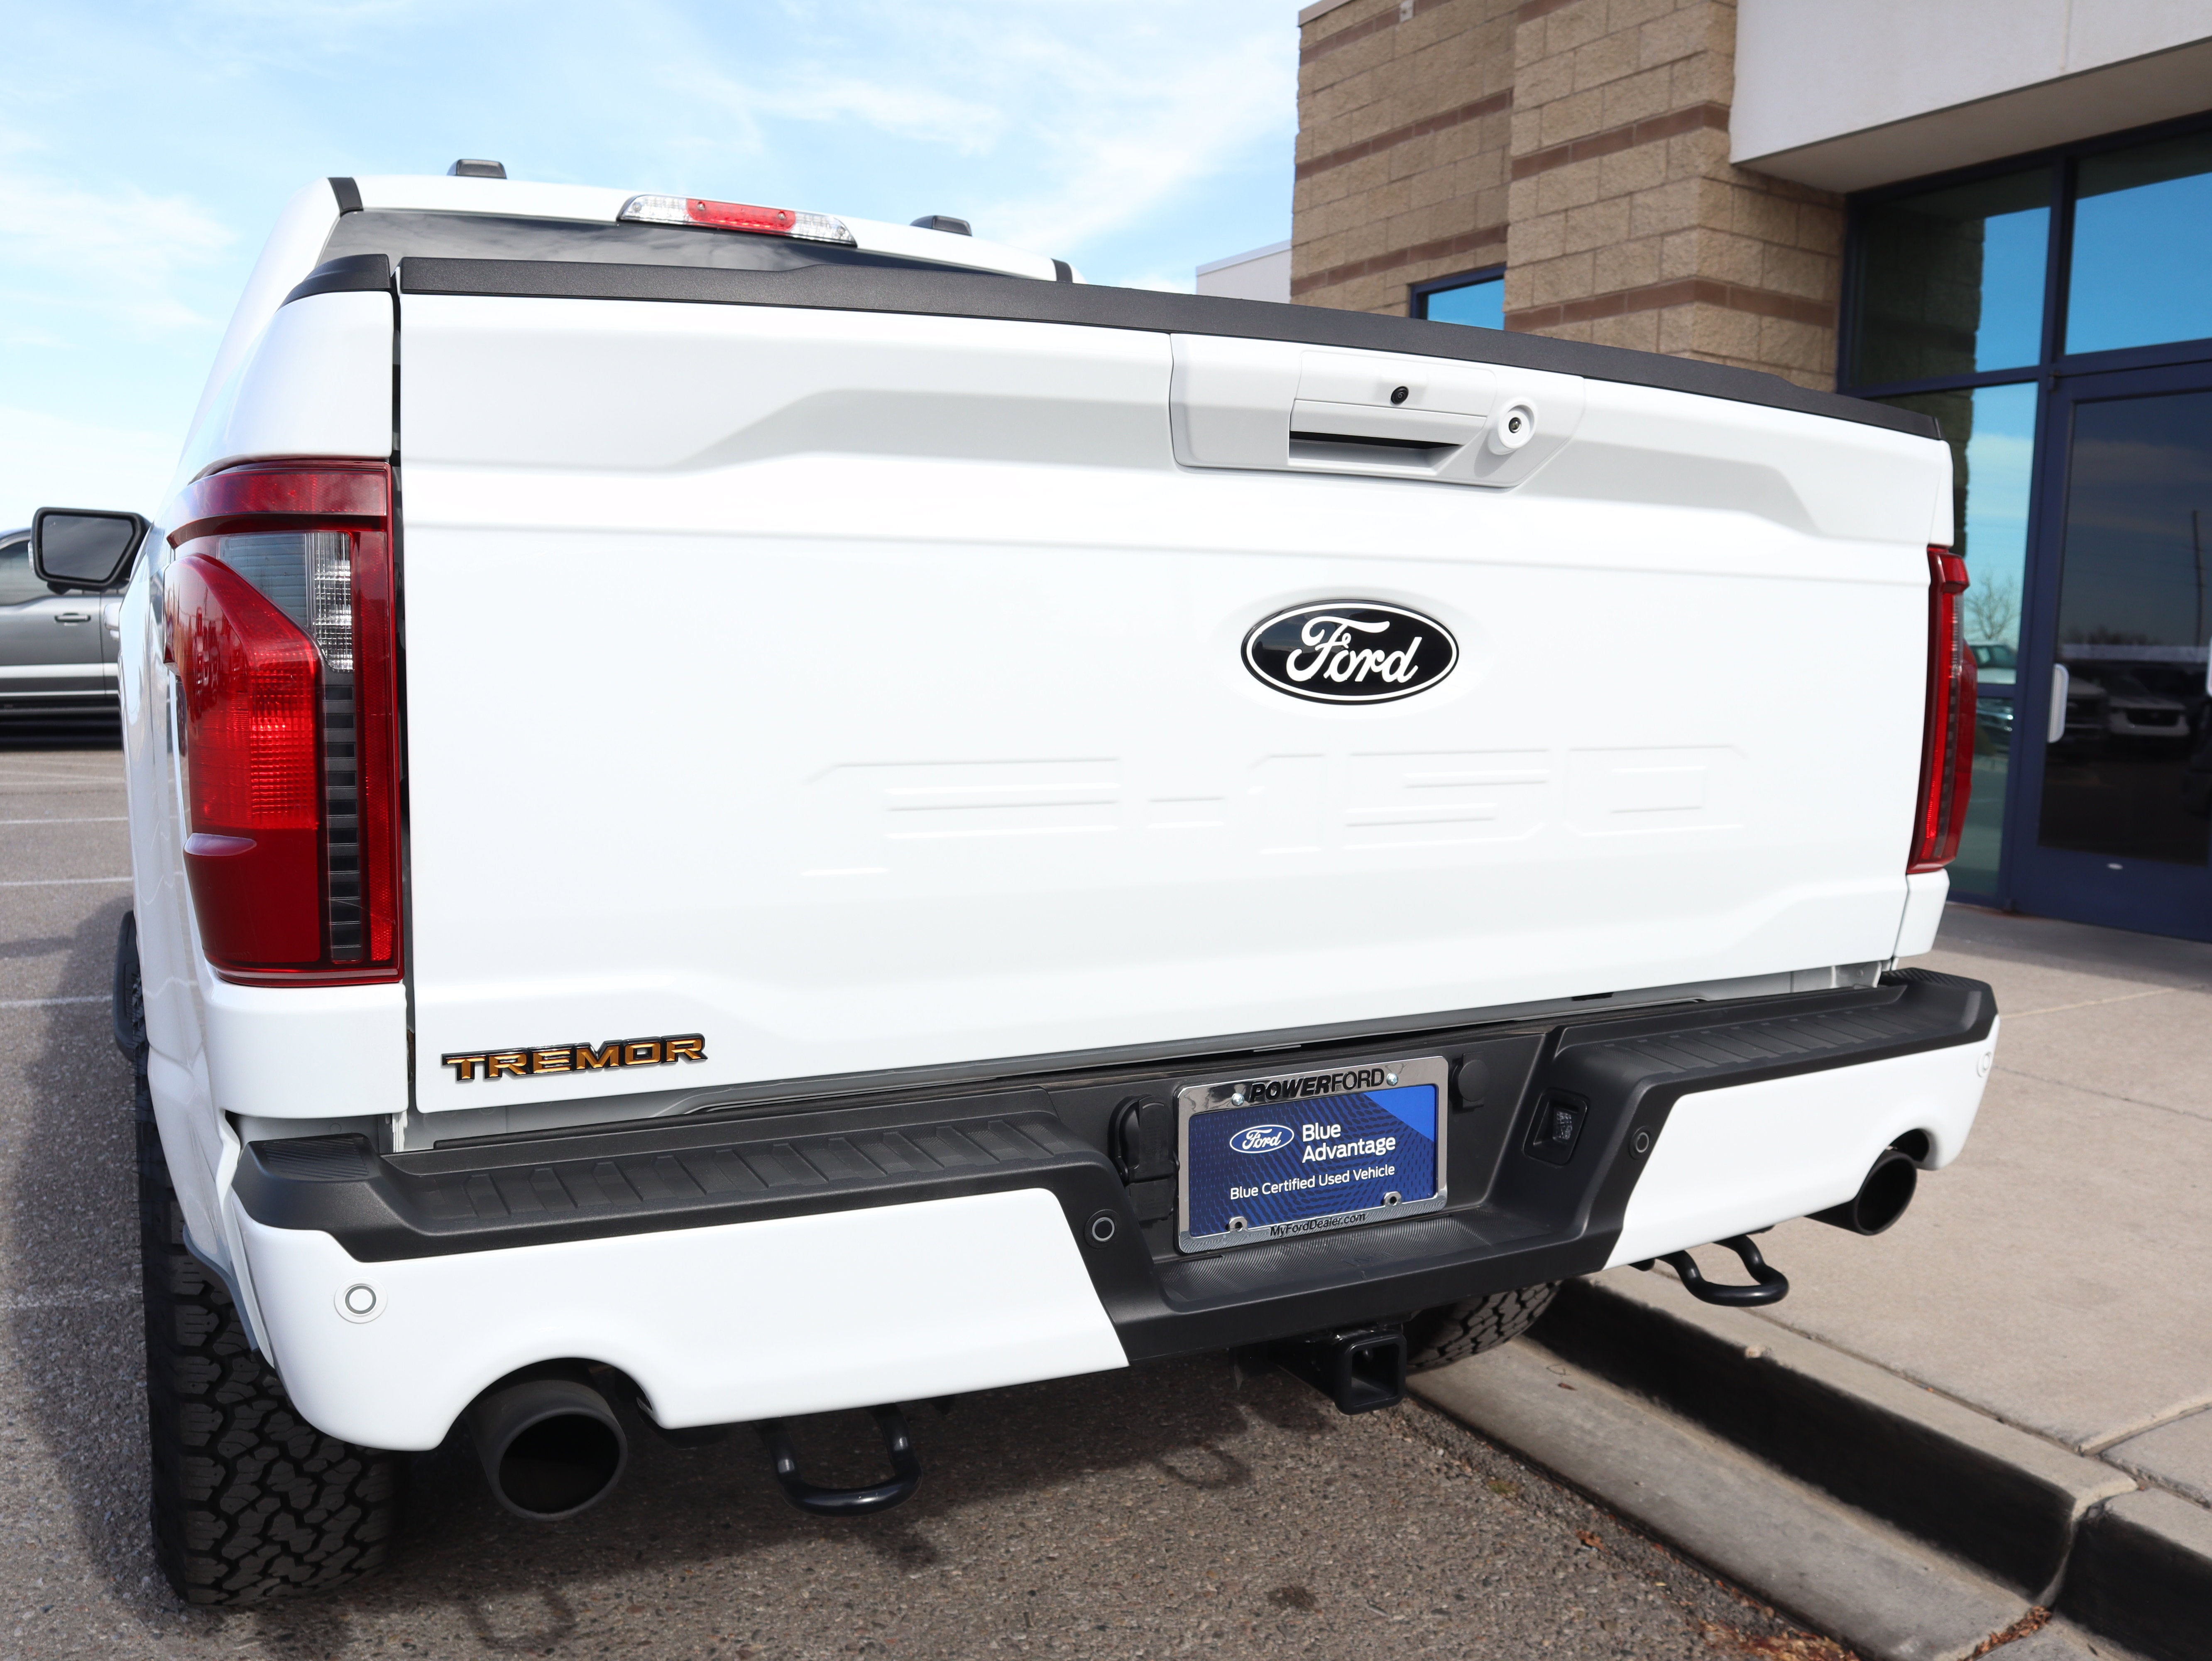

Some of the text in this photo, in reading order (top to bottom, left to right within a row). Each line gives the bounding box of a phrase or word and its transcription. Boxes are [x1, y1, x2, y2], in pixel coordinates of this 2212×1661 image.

[1286, 616, 1422, 683] Ford
[441, 1032, 708, 1081] TREMOR
[1248, 1068, 1385, 1104] POWERFORD
[1242, 1129, 1282, 1150] Ford
[1302, 1122, 1341, 1142] Blue
[1302, 1137, 1396, 1163] Advantage
[1230, 1164, 1395, 1200] Blue Certified Used Vehicle
[1270, 1213, 1365, 1237] MyFordDealer.com
